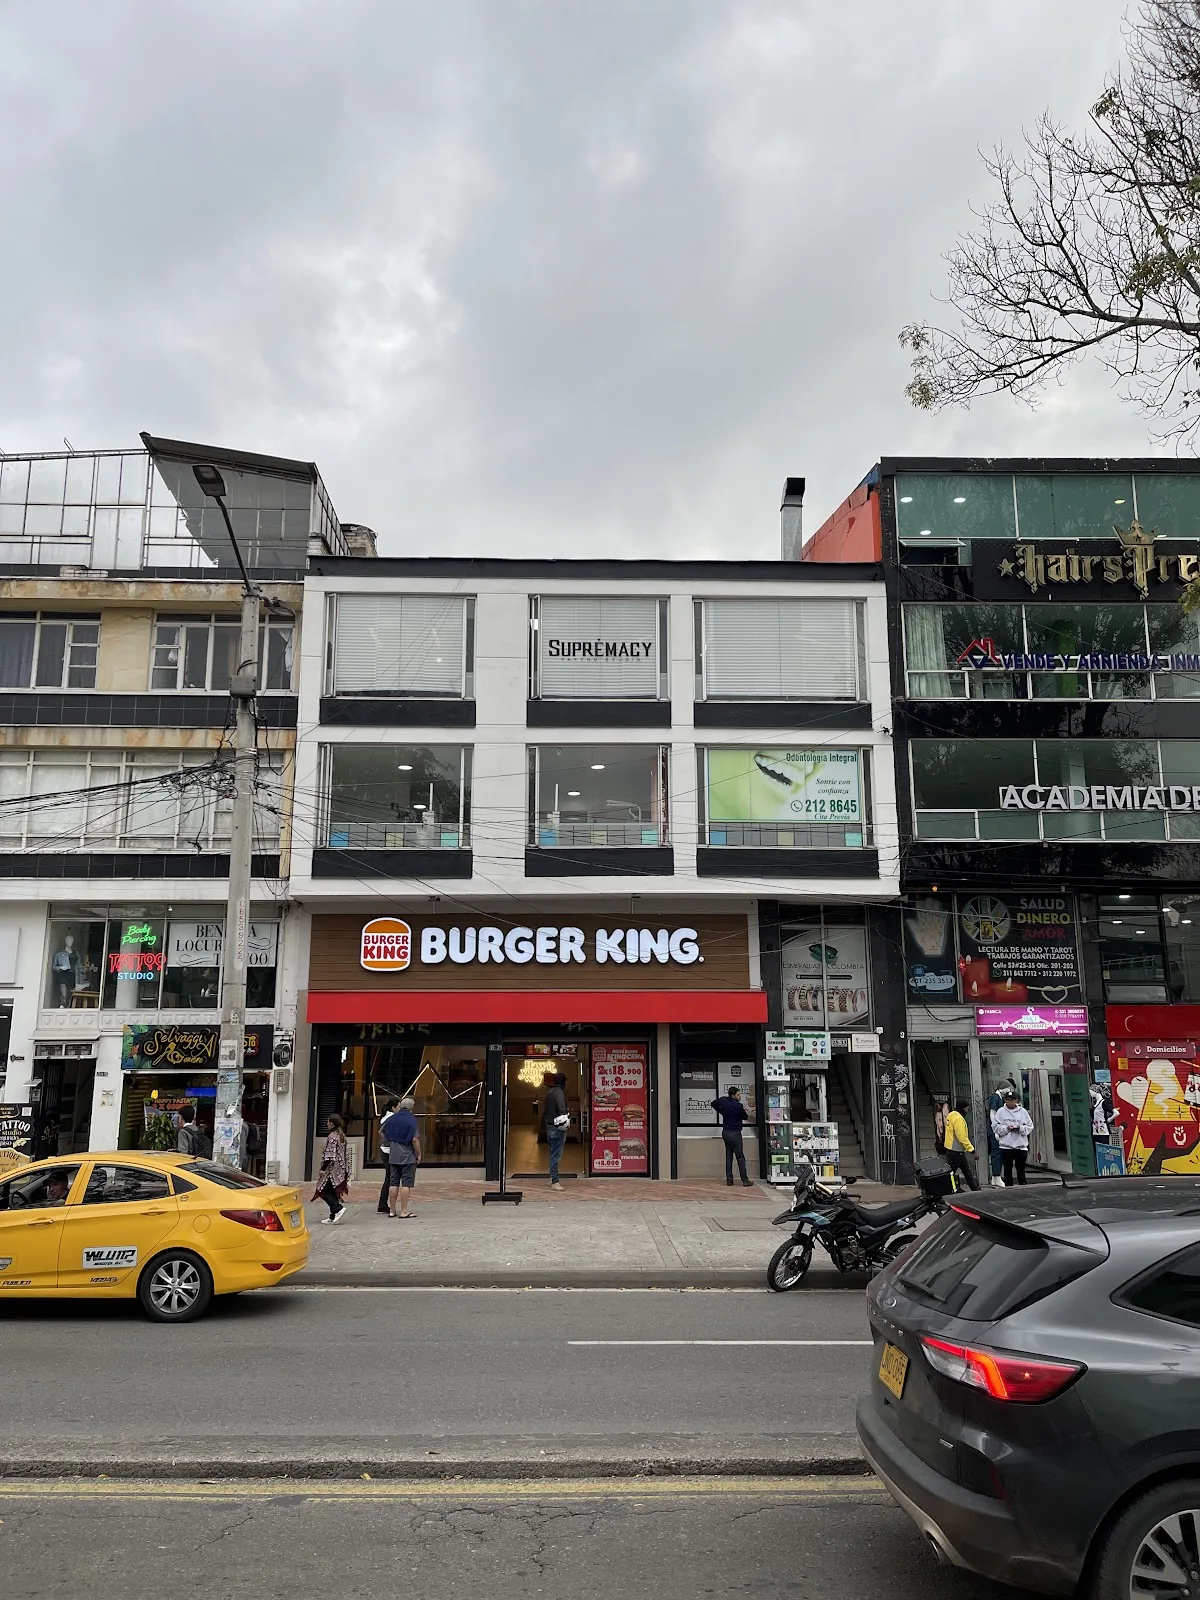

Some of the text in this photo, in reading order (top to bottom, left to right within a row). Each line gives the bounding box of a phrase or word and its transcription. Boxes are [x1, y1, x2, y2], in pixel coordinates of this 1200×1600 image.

[549, 639, 652, 657] SUPREMACY
[1002, 654, 1056, 670] VENDE
[1060, 654, 1069, 670] Y
[1078, 654, 1163, 670] ARRIENDA
[830, 753, 857, 764] Integral
[1002, 785, 1164, 810] ACADEMIA
[805, 799, 857, 813] 212 8645
[1020, 898, 1065, 910] SALUD
[1017, 913, 1071, 924] DINERO
[126, 923, 152, 936] Body
[1022, 927, 1067, 939] AMOR
[121, 935, 157, 946] Piercing
[364, 935, 409, 945] BURGER
[421, 926, 700, 965] BURGER KING
[363, 945, 409, 960] KING
[1021, 946, 1043, 954] MANO
[109, 953, 167, 974] TATTOO
[783, 961, 821, 969] ESMERALDAS
[117, 972, 154, 981] STUDIO
[1146, 1045, 1187, 1053] Domicilios
